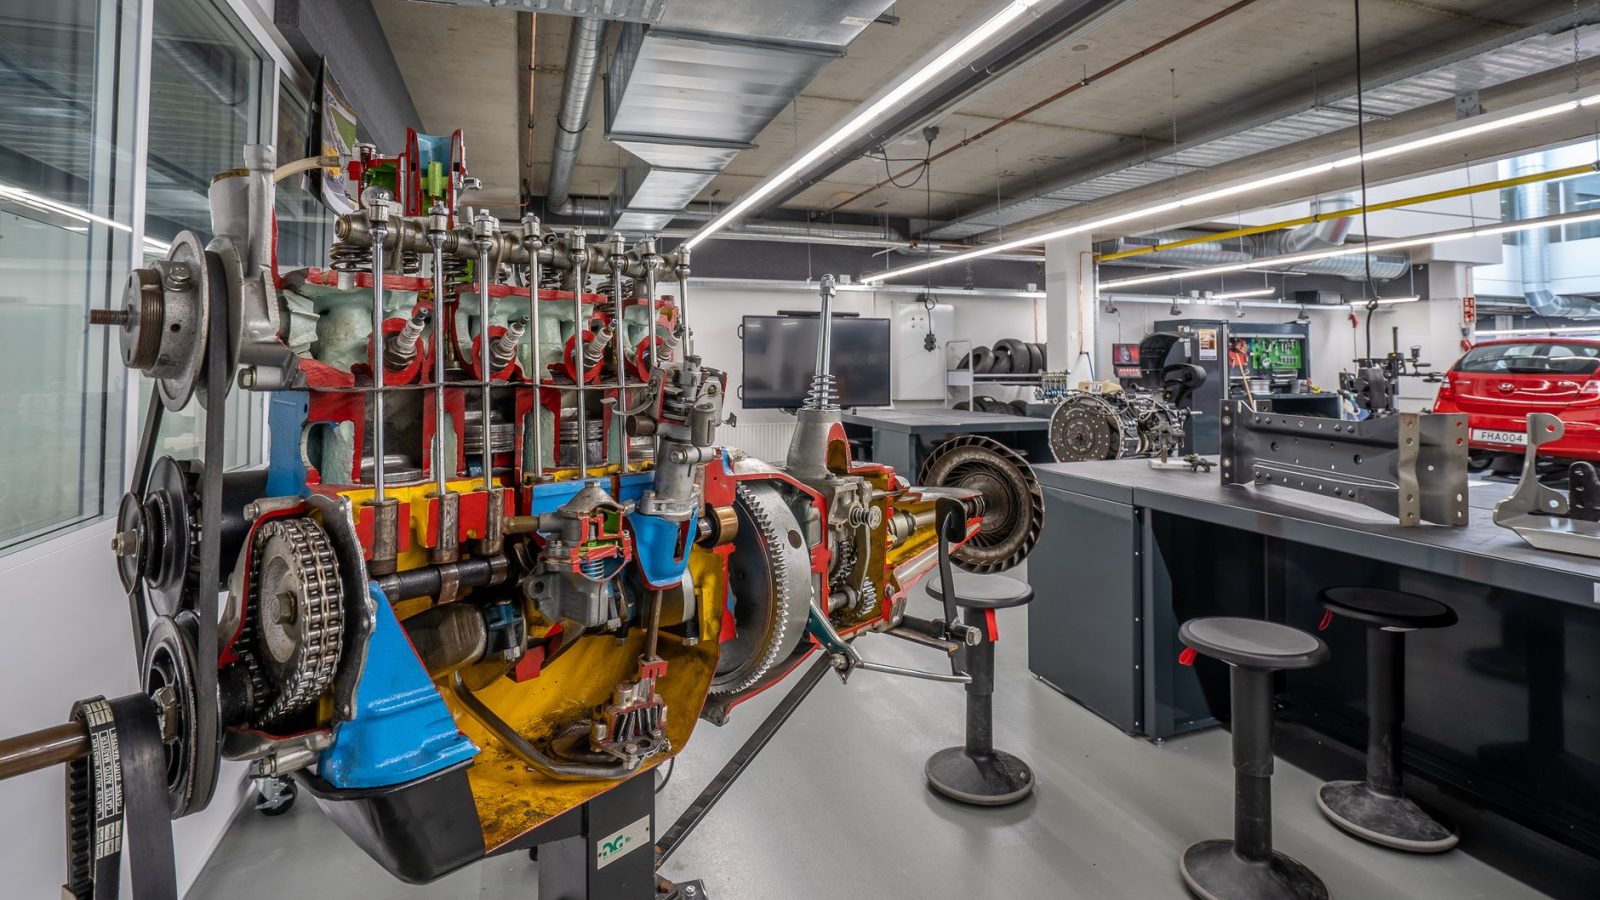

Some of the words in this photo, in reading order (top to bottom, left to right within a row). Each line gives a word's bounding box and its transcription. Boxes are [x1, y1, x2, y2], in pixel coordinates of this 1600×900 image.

[1481, 432, 1523, 442] FHA004
[92, 739, 100, 766] MASTER
[102, 736, 110, 762] MASTER
[104, 766, 112, 785] AUTO
[105, 788, 113, 810] GATES
